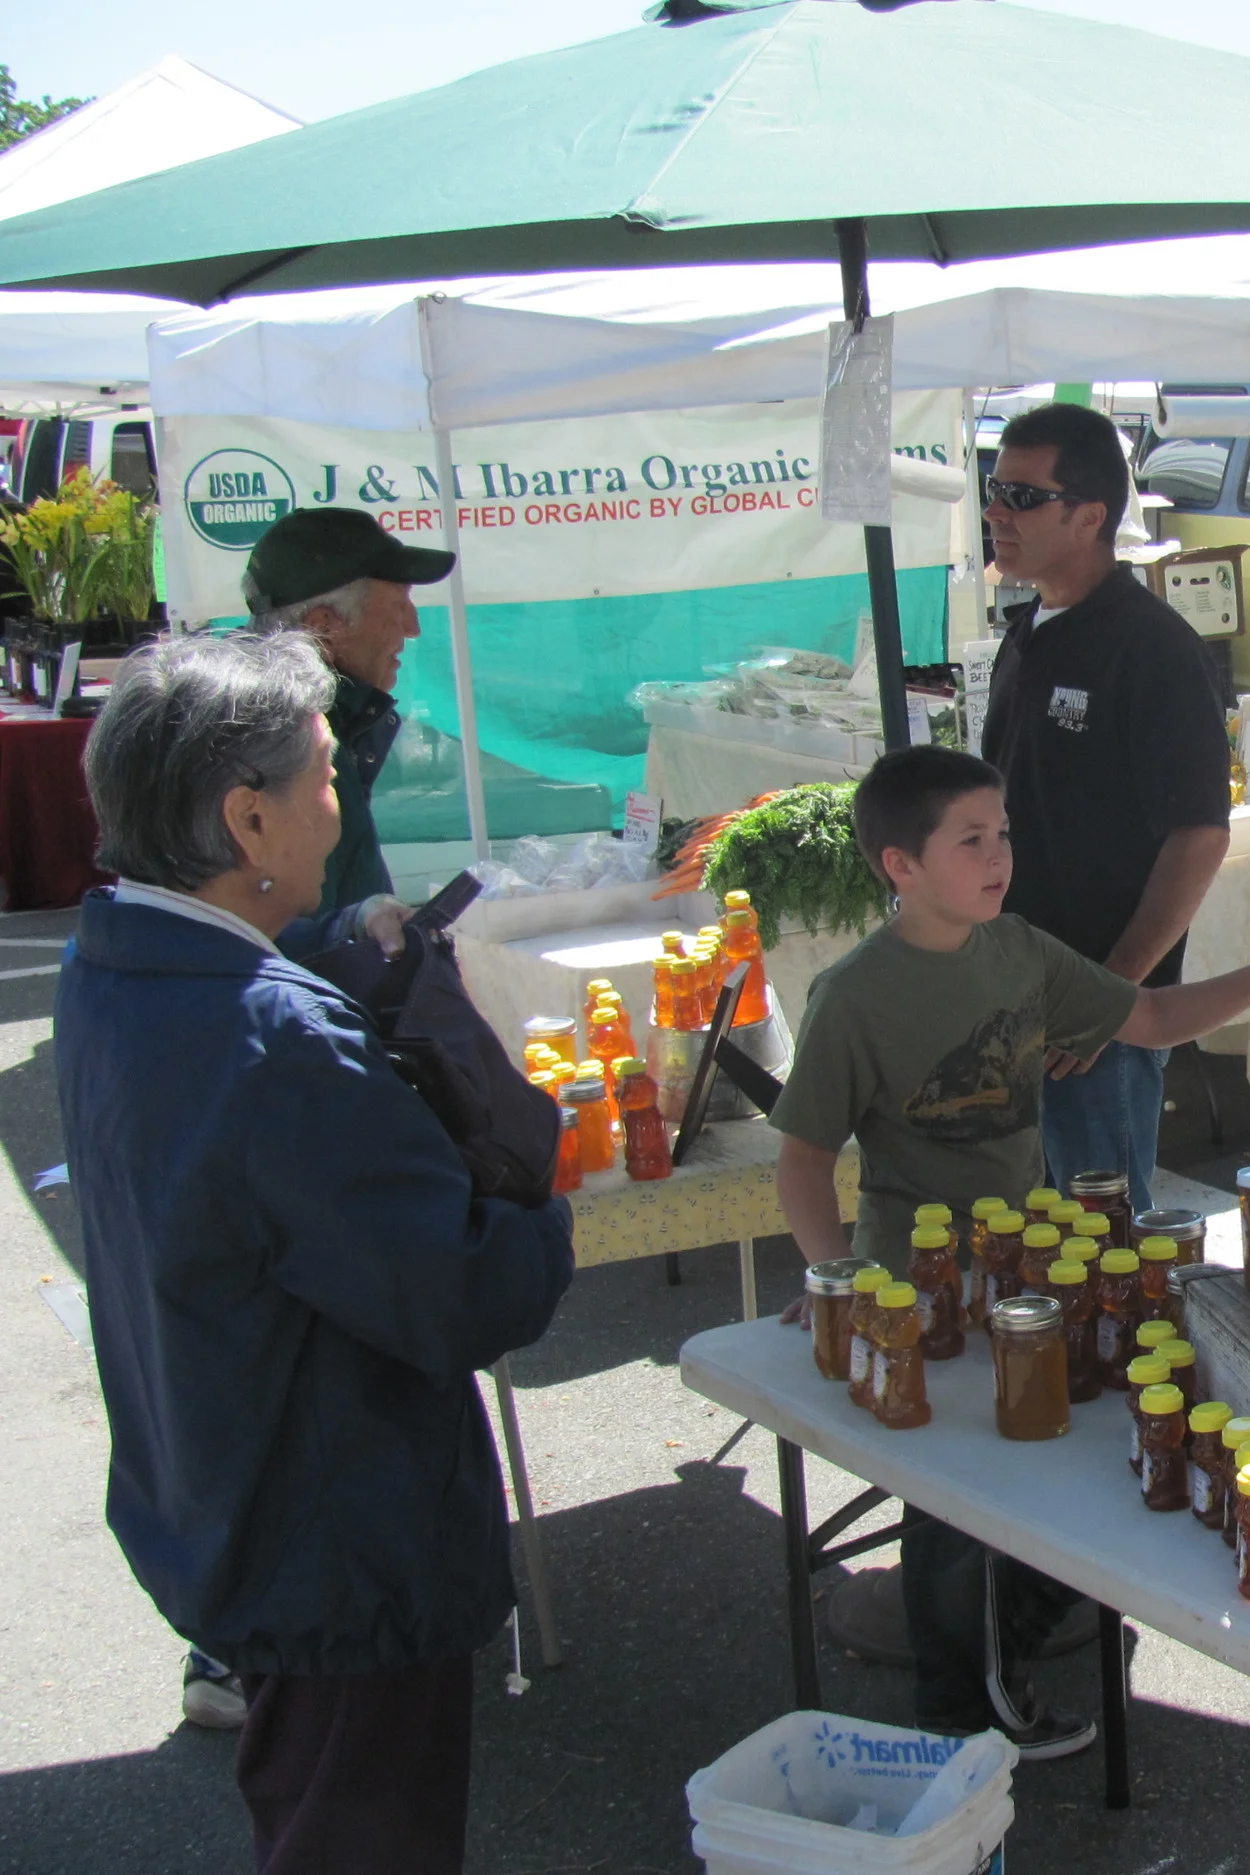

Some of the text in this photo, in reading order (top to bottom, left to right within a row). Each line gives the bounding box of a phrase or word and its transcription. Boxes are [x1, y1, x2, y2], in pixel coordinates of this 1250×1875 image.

[209, 472, 268, 498] USDA
[313, 464, 340, 503] J
[359, 465, 400, 503] &
[478, 463, 628, 499] Ibarra
[641, 449, 815, 498] Organic
[203, 502, 277, 524] ORGANIC
[378, 506, 515, 533] CERTFIED
[524, 499, 641, 525] ORGANIC
[650, 498, 683, 518] BY
[690, 491, 792, 514] GLOBAL
[1050, 686, 1088, 709] YOUNG
[1048, 704, 1088, 721] COUNTRY
[1057, 718, 1084, 733] 93.3
